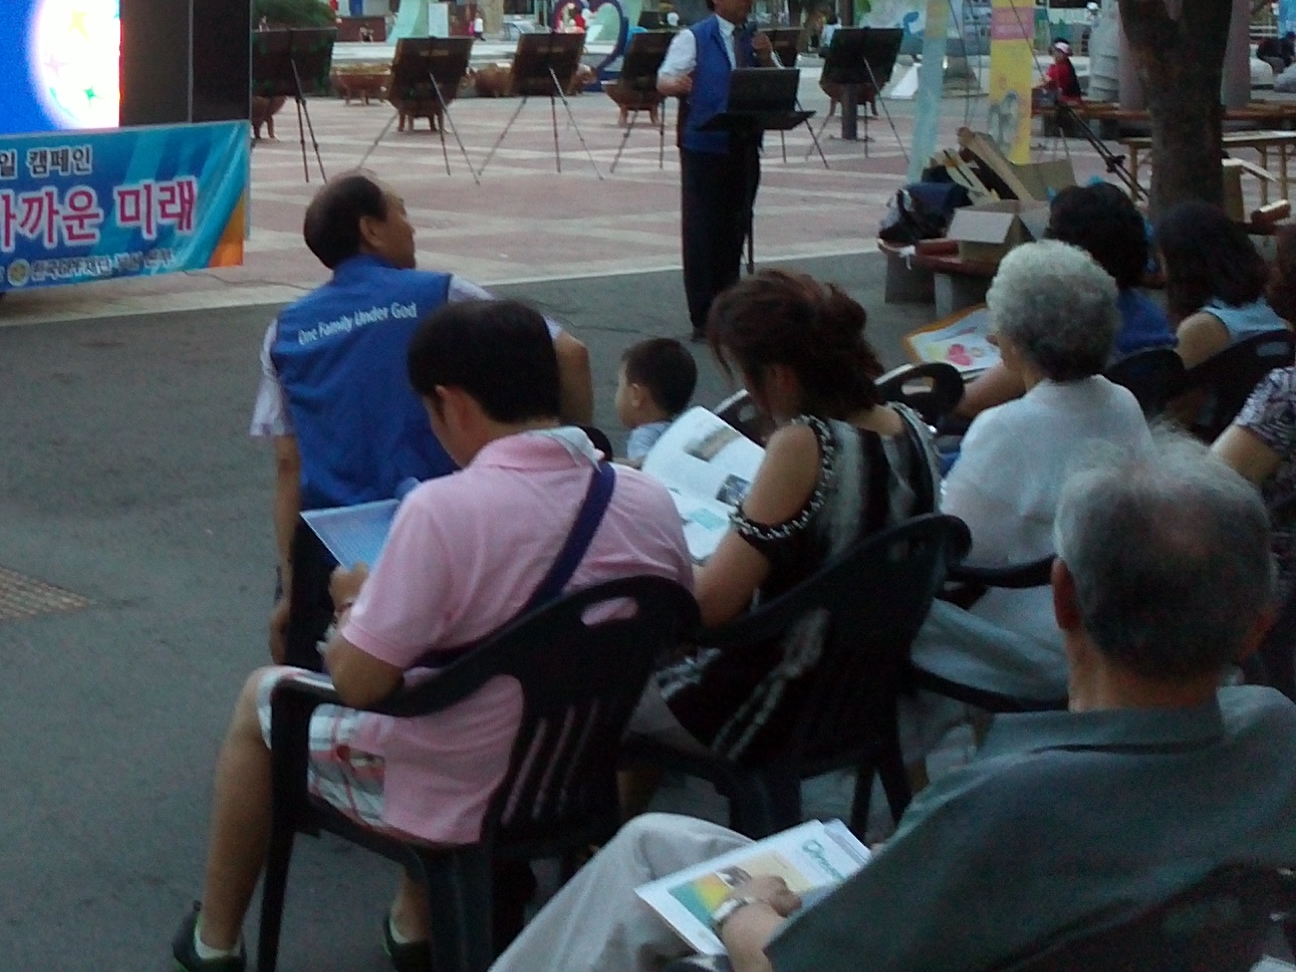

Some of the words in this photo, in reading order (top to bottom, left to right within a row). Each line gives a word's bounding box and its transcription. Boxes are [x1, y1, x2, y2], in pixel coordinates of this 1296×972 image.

[26, 146, 93, 177] 캠페인
[114, 175, 199, 239] 미래
[390, 301, 418, 319] God
